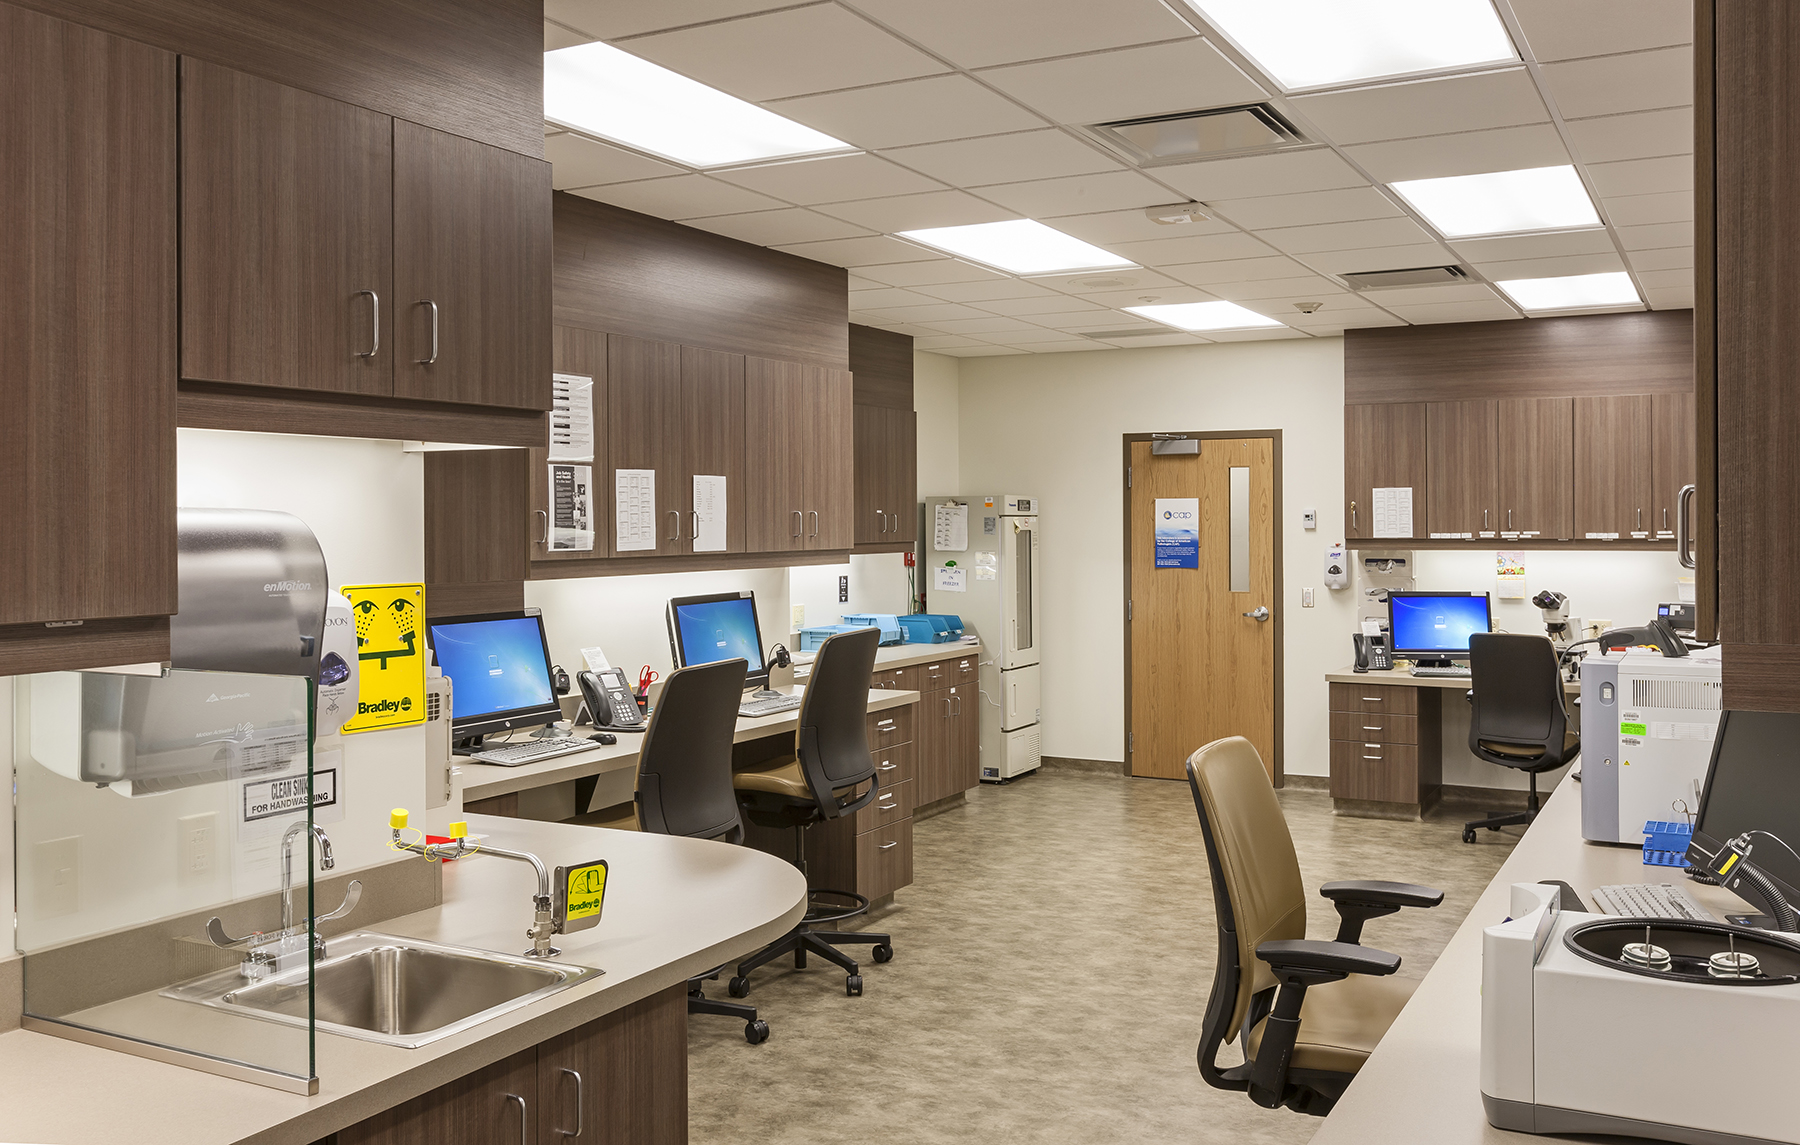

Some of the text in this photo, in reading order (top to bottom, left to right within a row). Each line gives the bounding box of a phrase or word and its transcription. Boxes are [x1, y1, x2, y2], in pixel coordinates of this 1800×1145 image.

[263, 580, 310, 592] enMotion
[324, 617, 348, 627] OVON
[358, 699, 400, 714] Bradley
[271, 780, 292, 800] CLEAN
[252, 803, 268, 814] FOR
[569, 901, 593, 912] Bradley
